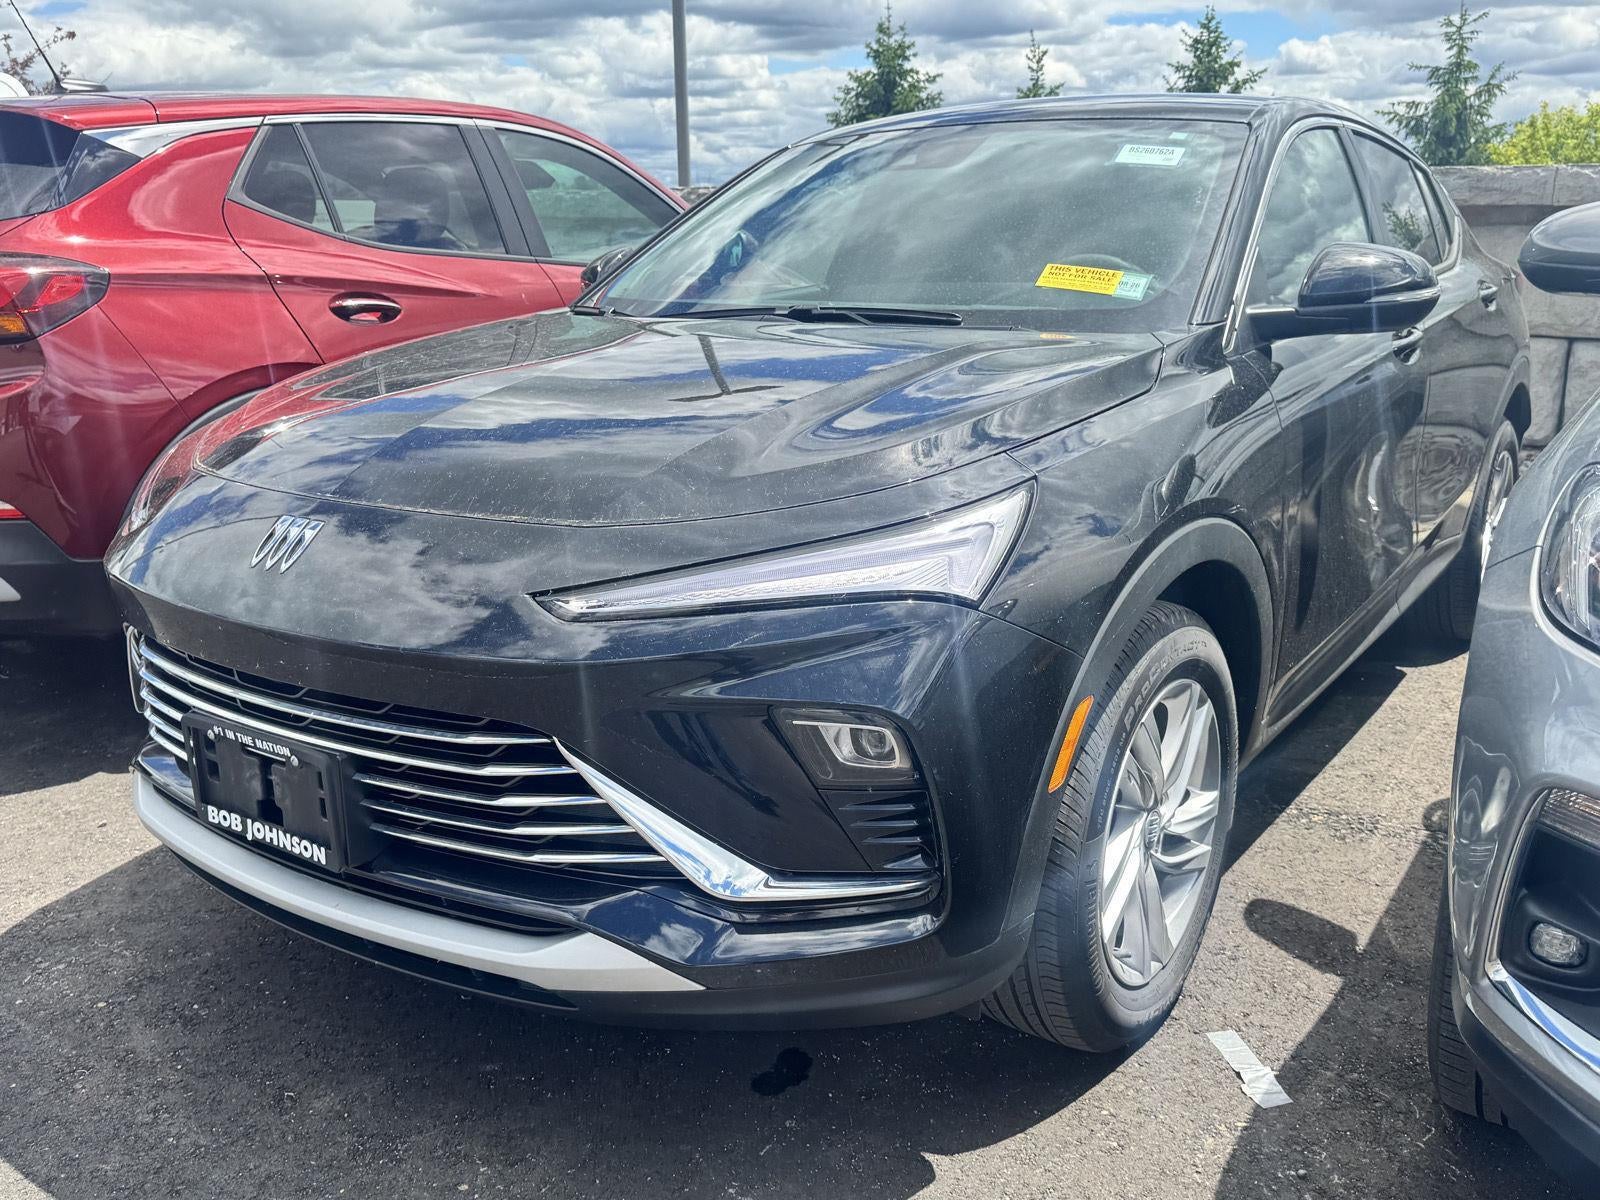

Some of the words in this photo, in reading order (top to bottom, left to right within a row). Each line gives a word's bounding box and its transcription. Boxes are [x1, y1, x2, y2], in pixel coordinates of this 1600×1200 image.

[1075, 267, 1118, 278] VEHICLE
[213, 726, 224, 736] #1
[225, 729, 235, 740] IN
[237, 732, 254, 748] THE
[255, 739, 291, 757] NATION
[207, 805, 243, 832] BOB
[246, 818, 327, 865] JOHNSON
